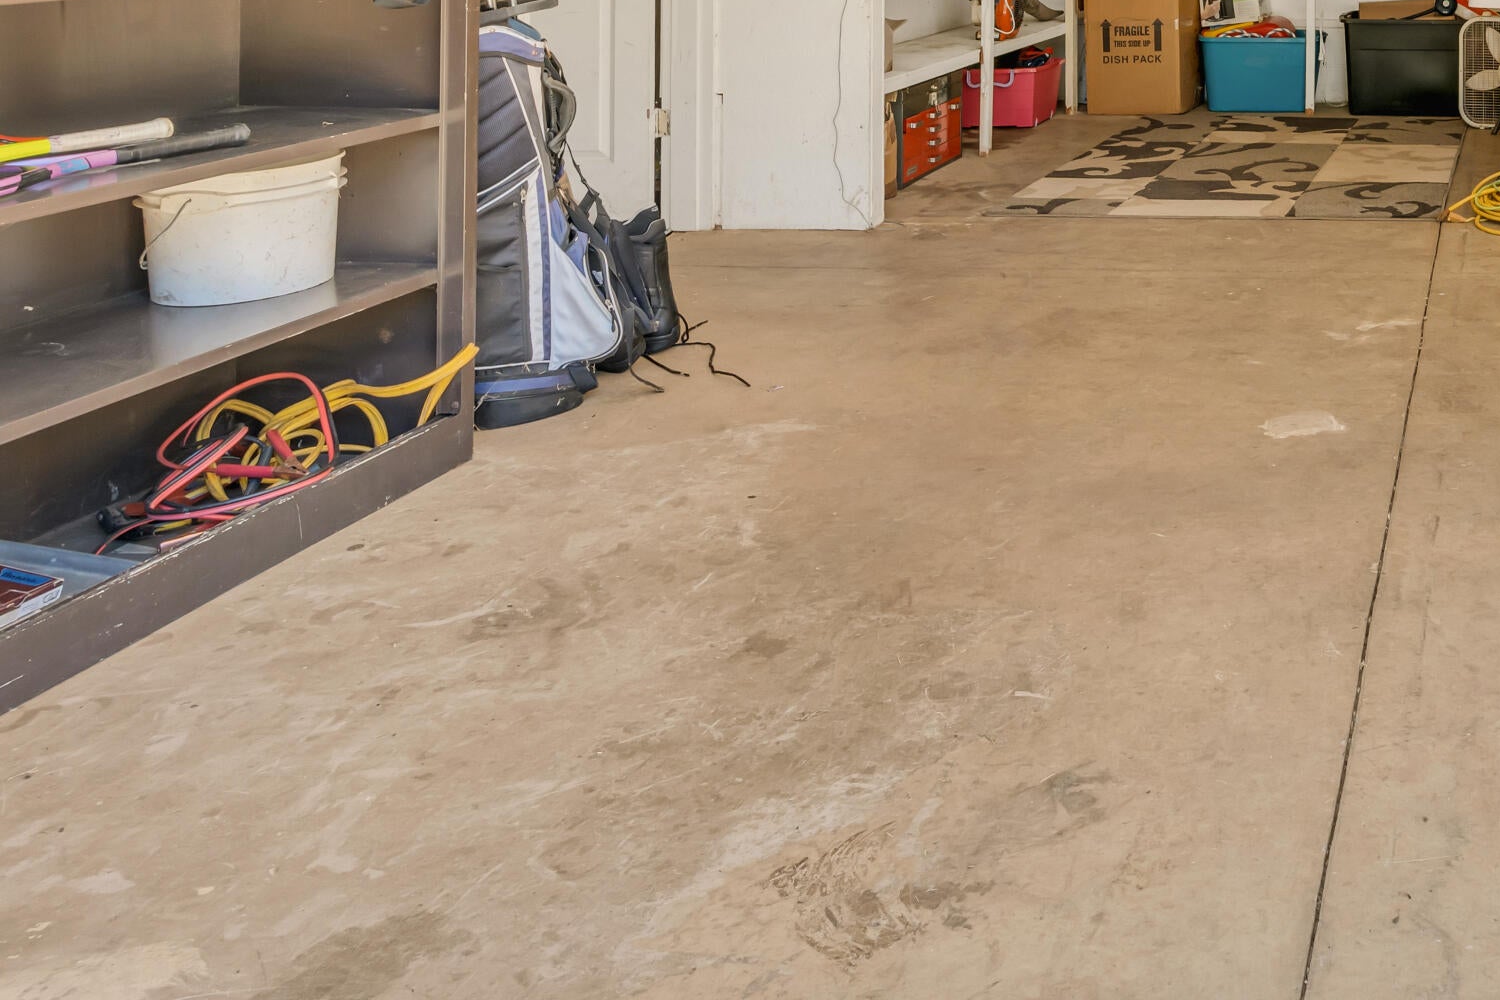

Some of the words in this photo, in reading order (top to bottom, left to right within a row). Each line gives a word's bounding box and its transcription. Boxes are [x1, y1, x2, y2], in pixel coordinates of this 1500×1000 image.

[1113, 25, 1150, 36] FRAGILE
[1114, 40, 1127, 48] THIS
[1143, 39, 1151, 47] UP
[1102, 55, 1129, 64] DISH
[1132, 54, 1162, 63] PACK
